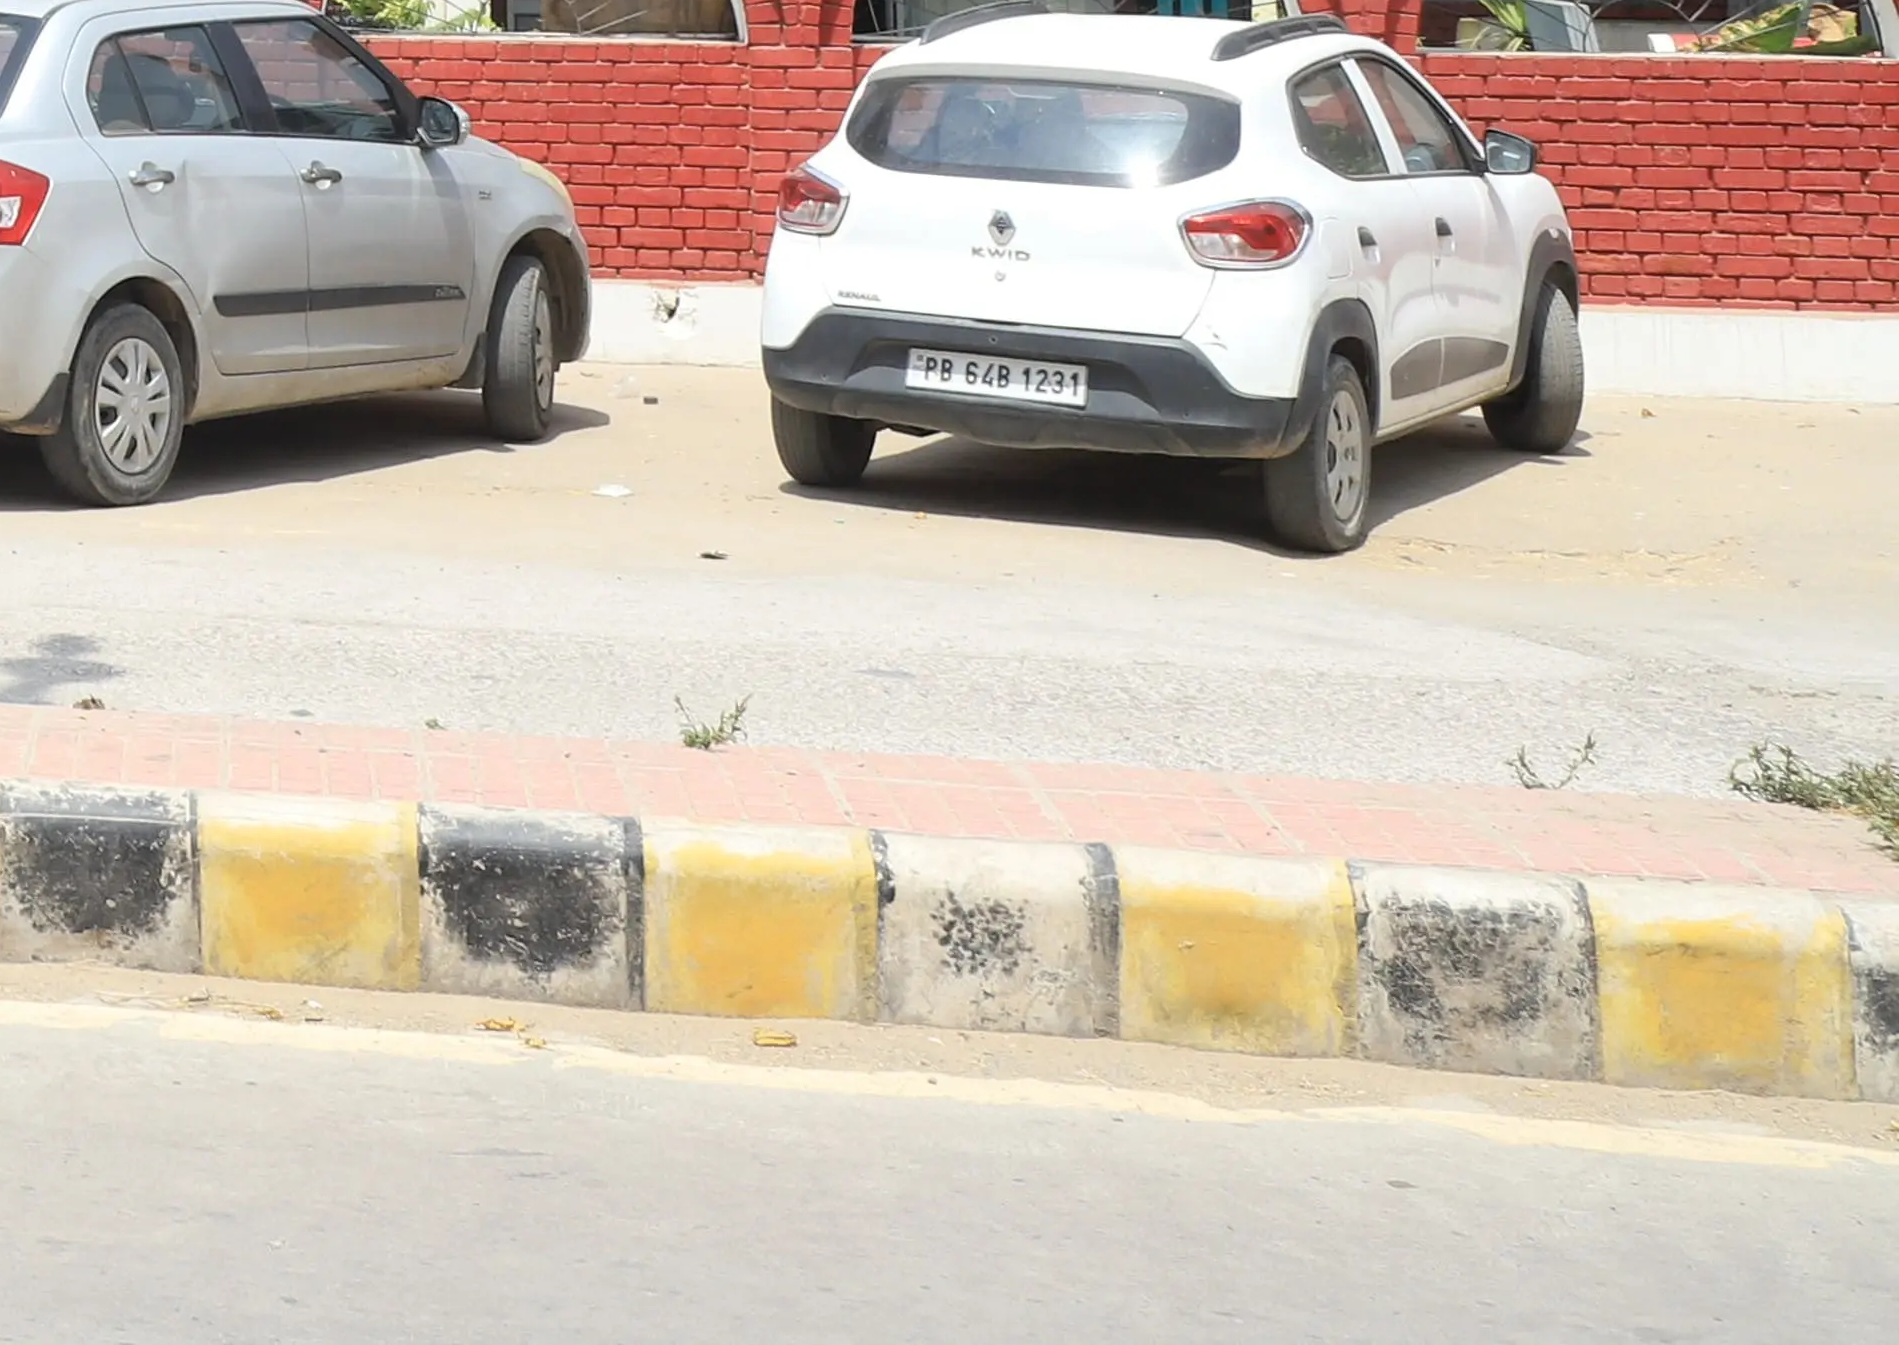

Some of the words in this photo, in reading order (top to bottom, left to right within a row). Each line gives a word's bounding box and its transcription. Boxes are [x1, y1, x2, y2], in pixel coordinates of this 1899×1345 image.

[971, 246, 1031, 261] KWID
[924, 356, 953, 382] PB
[965, 361, 1011, 388] 64B
[1022, 367, 1079, 396] 1231
